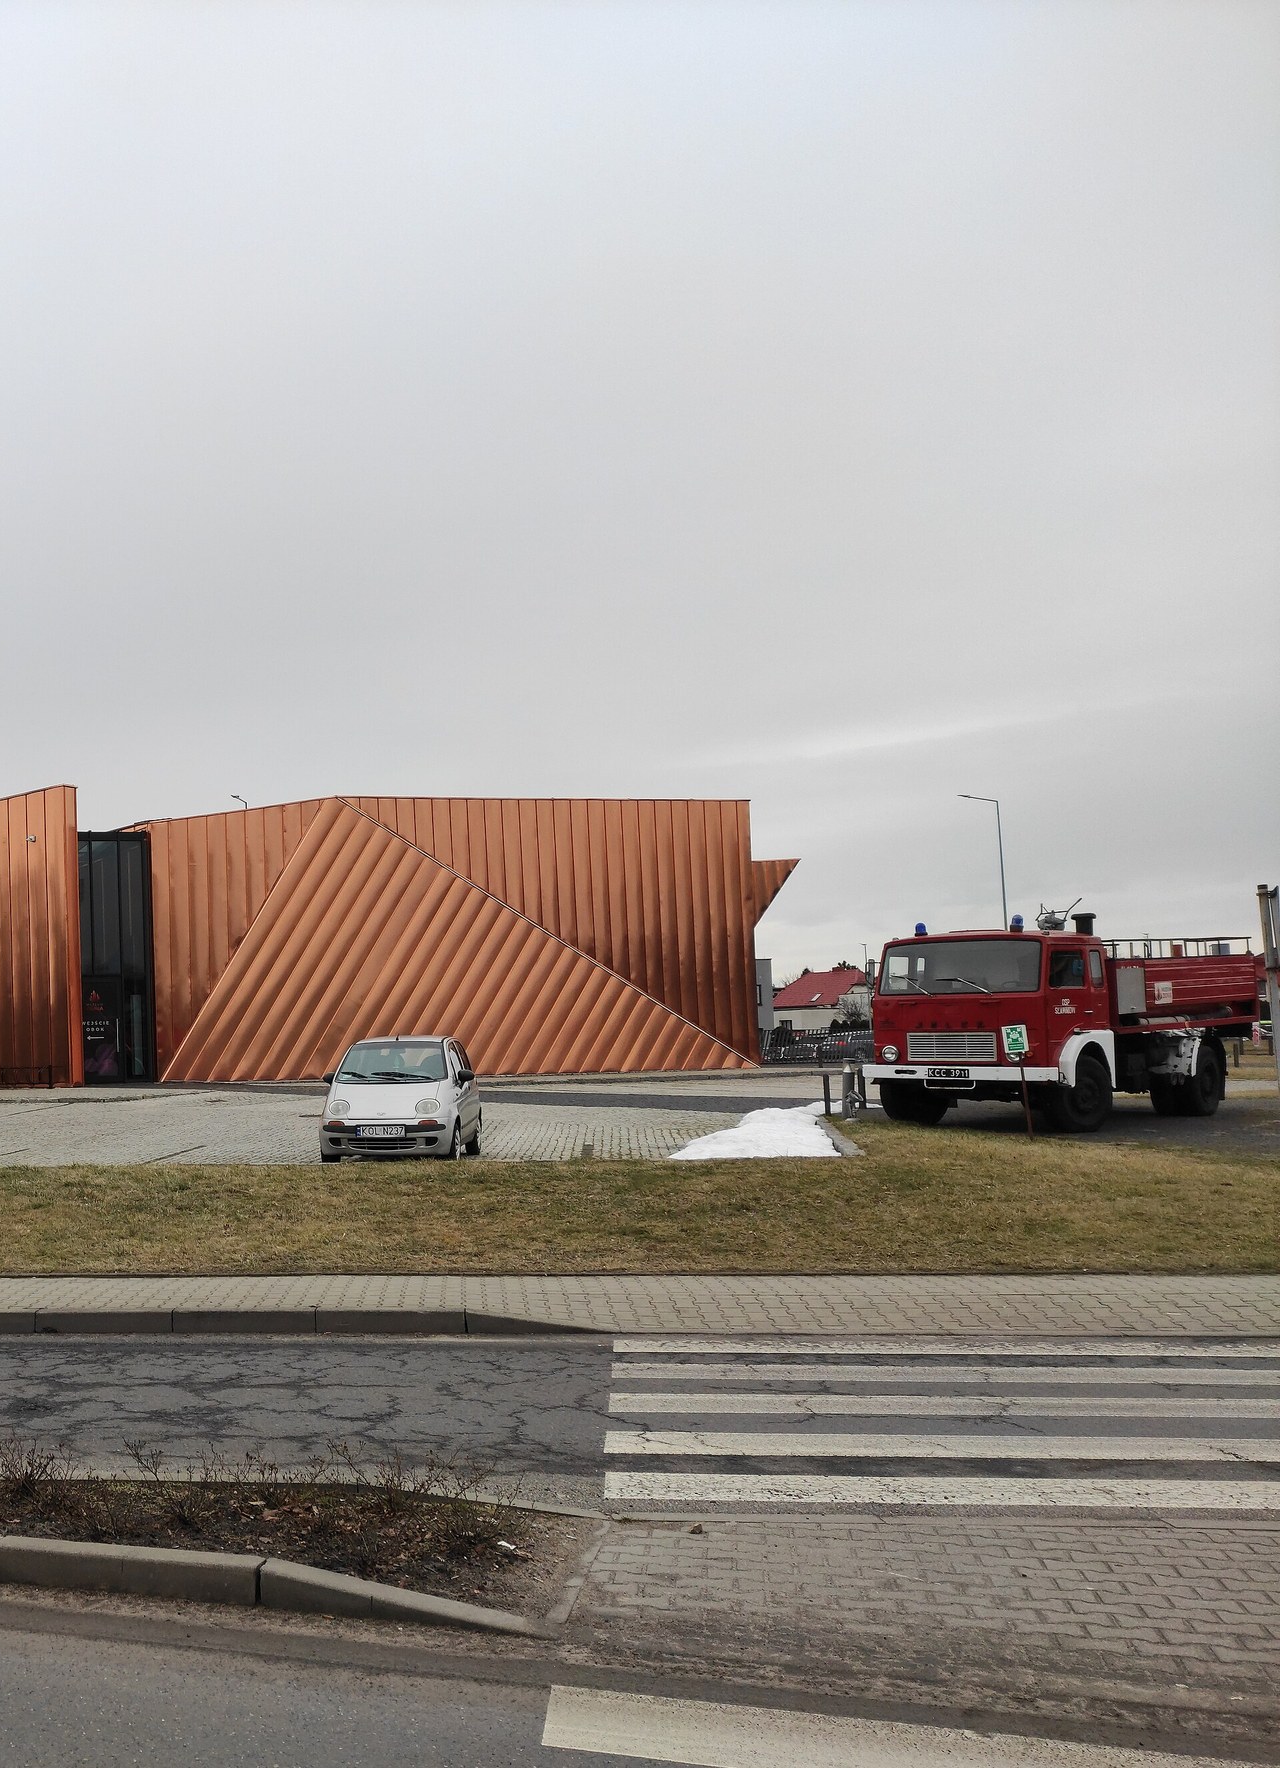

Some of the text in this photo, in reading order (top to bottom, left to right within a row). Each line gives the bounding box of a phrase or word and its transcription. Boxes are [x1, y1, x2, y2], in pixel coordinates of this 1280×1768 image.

[928, 1069, 947, 1077] KCC
[361, 1126, 403, 1135] KOL N237
